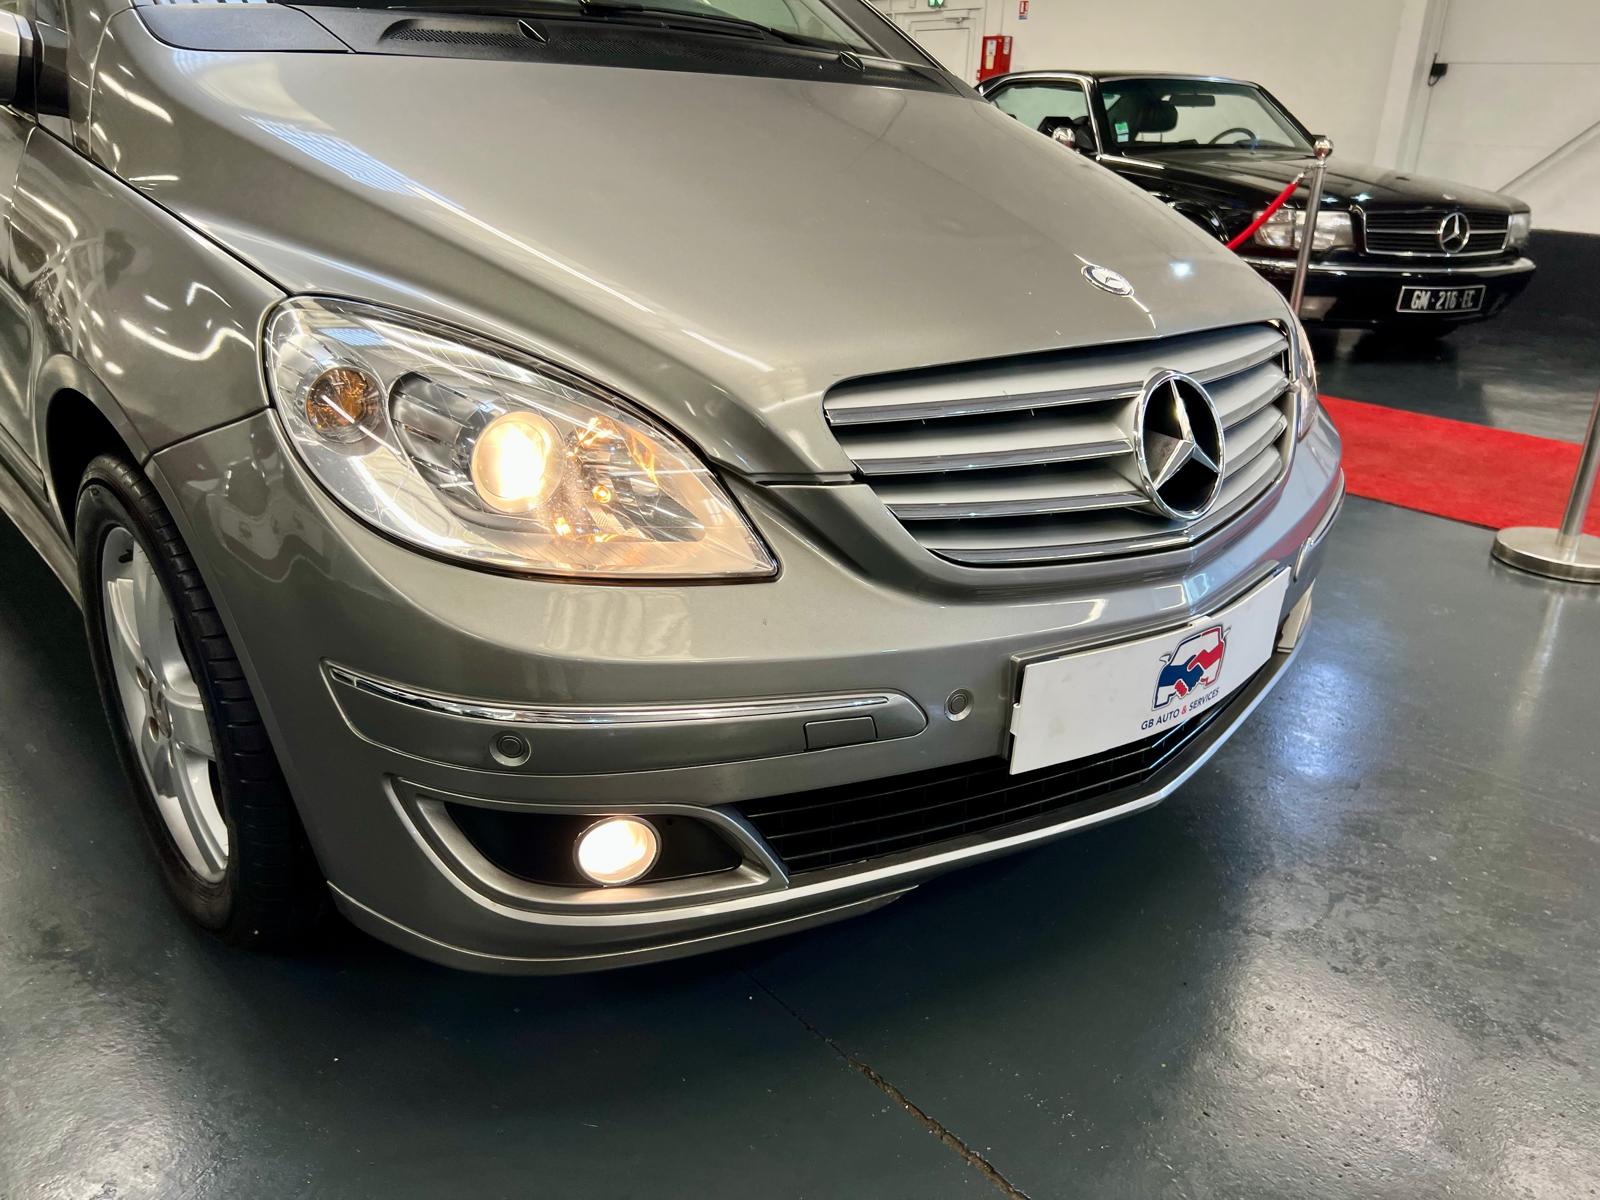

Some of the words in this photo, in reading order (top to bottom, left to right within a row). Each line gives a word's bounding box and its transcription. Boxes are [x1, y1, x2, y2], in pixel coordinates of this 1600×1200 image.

[1141, 719, 1154, 730] GB
[1156, 709, 1180, 725] AUTO
[1181, 704, 1188, 715] &
[1189, 687, 1219, 711] SERVICES
